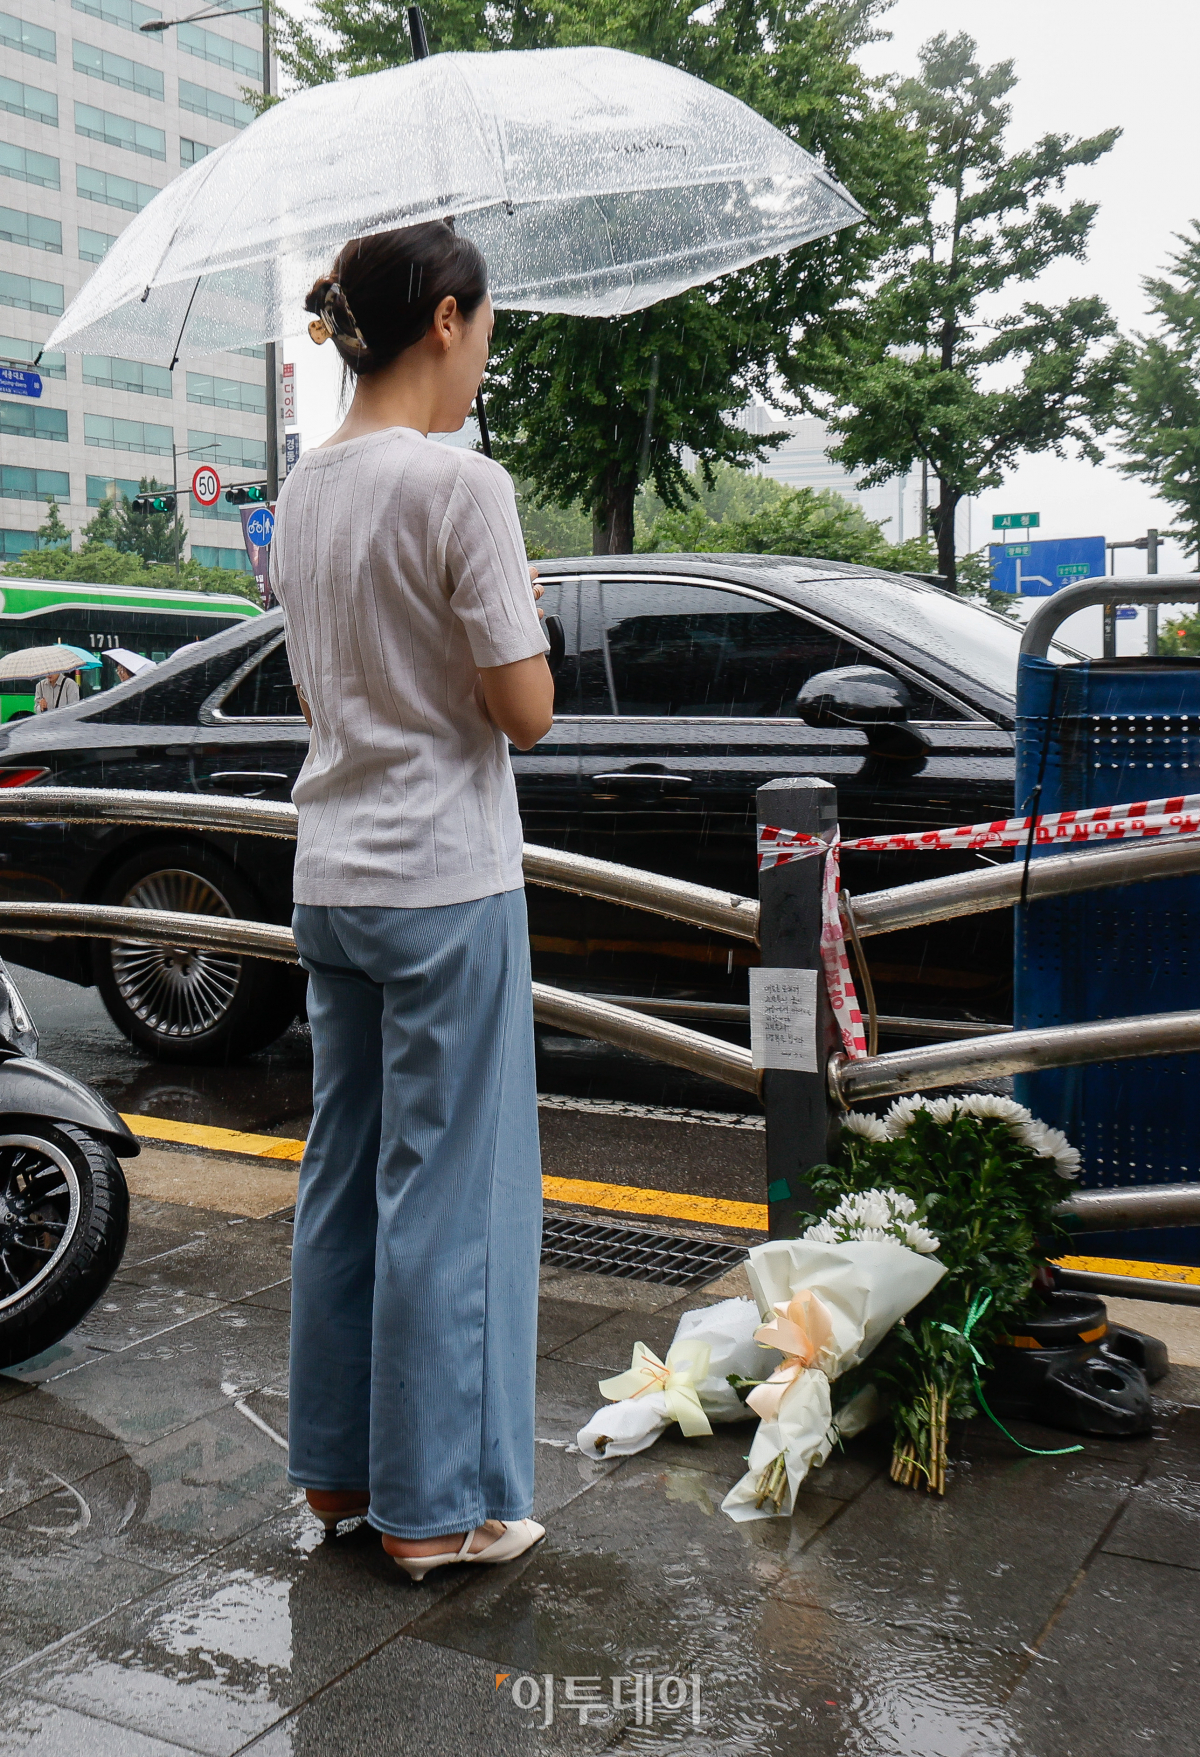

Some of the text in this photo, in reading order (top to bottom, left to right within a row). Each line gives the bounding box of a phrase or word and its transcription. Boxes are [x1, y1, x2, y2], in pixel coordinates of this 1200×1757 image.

[285, 384, 294, 418] 다이소
[199, 476, 215, 495] 50
[89, 634, 119, 648] 1711
